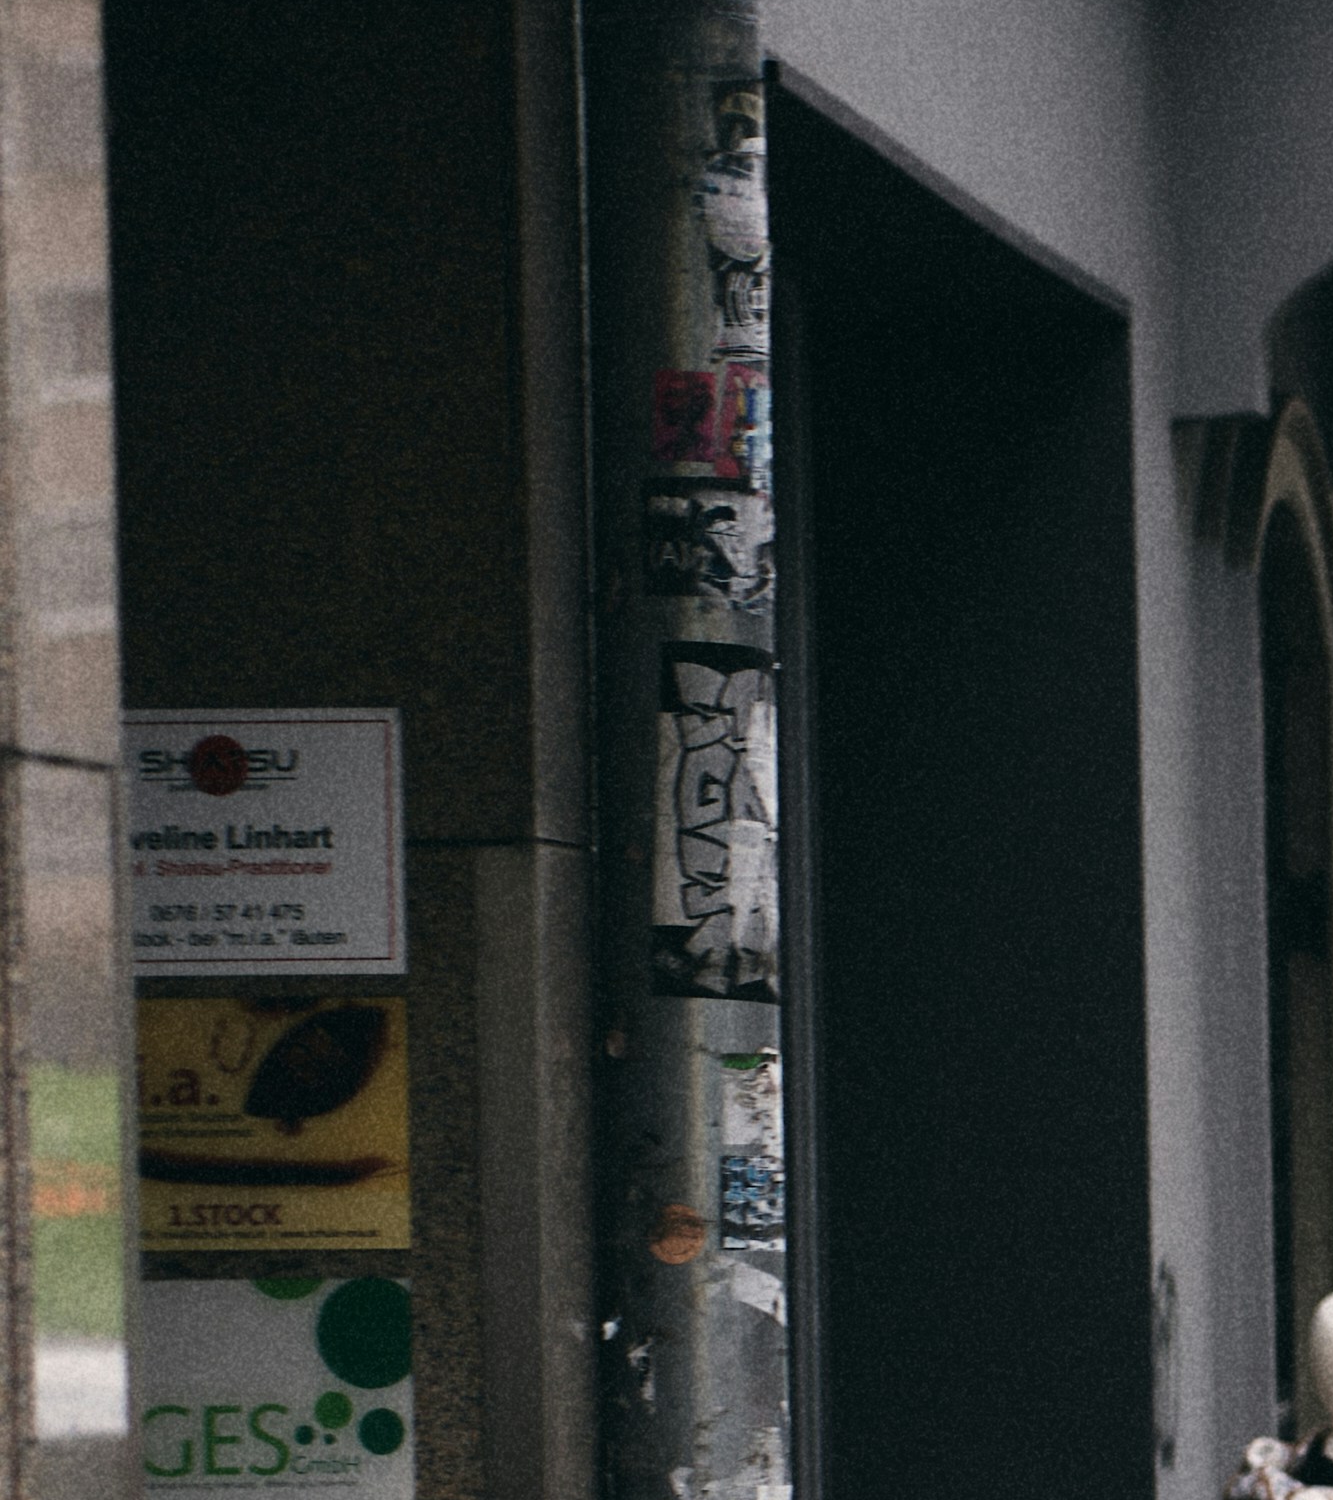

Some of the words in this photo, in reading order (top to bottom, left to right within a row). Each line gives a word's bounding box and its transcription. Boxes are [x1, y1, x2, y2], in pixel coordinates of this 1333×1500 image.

[225, 825, 334, 850] Linhart
[142, 1403, 291, 1478] GES
[291, 1454, 361, 1476] GmbH
